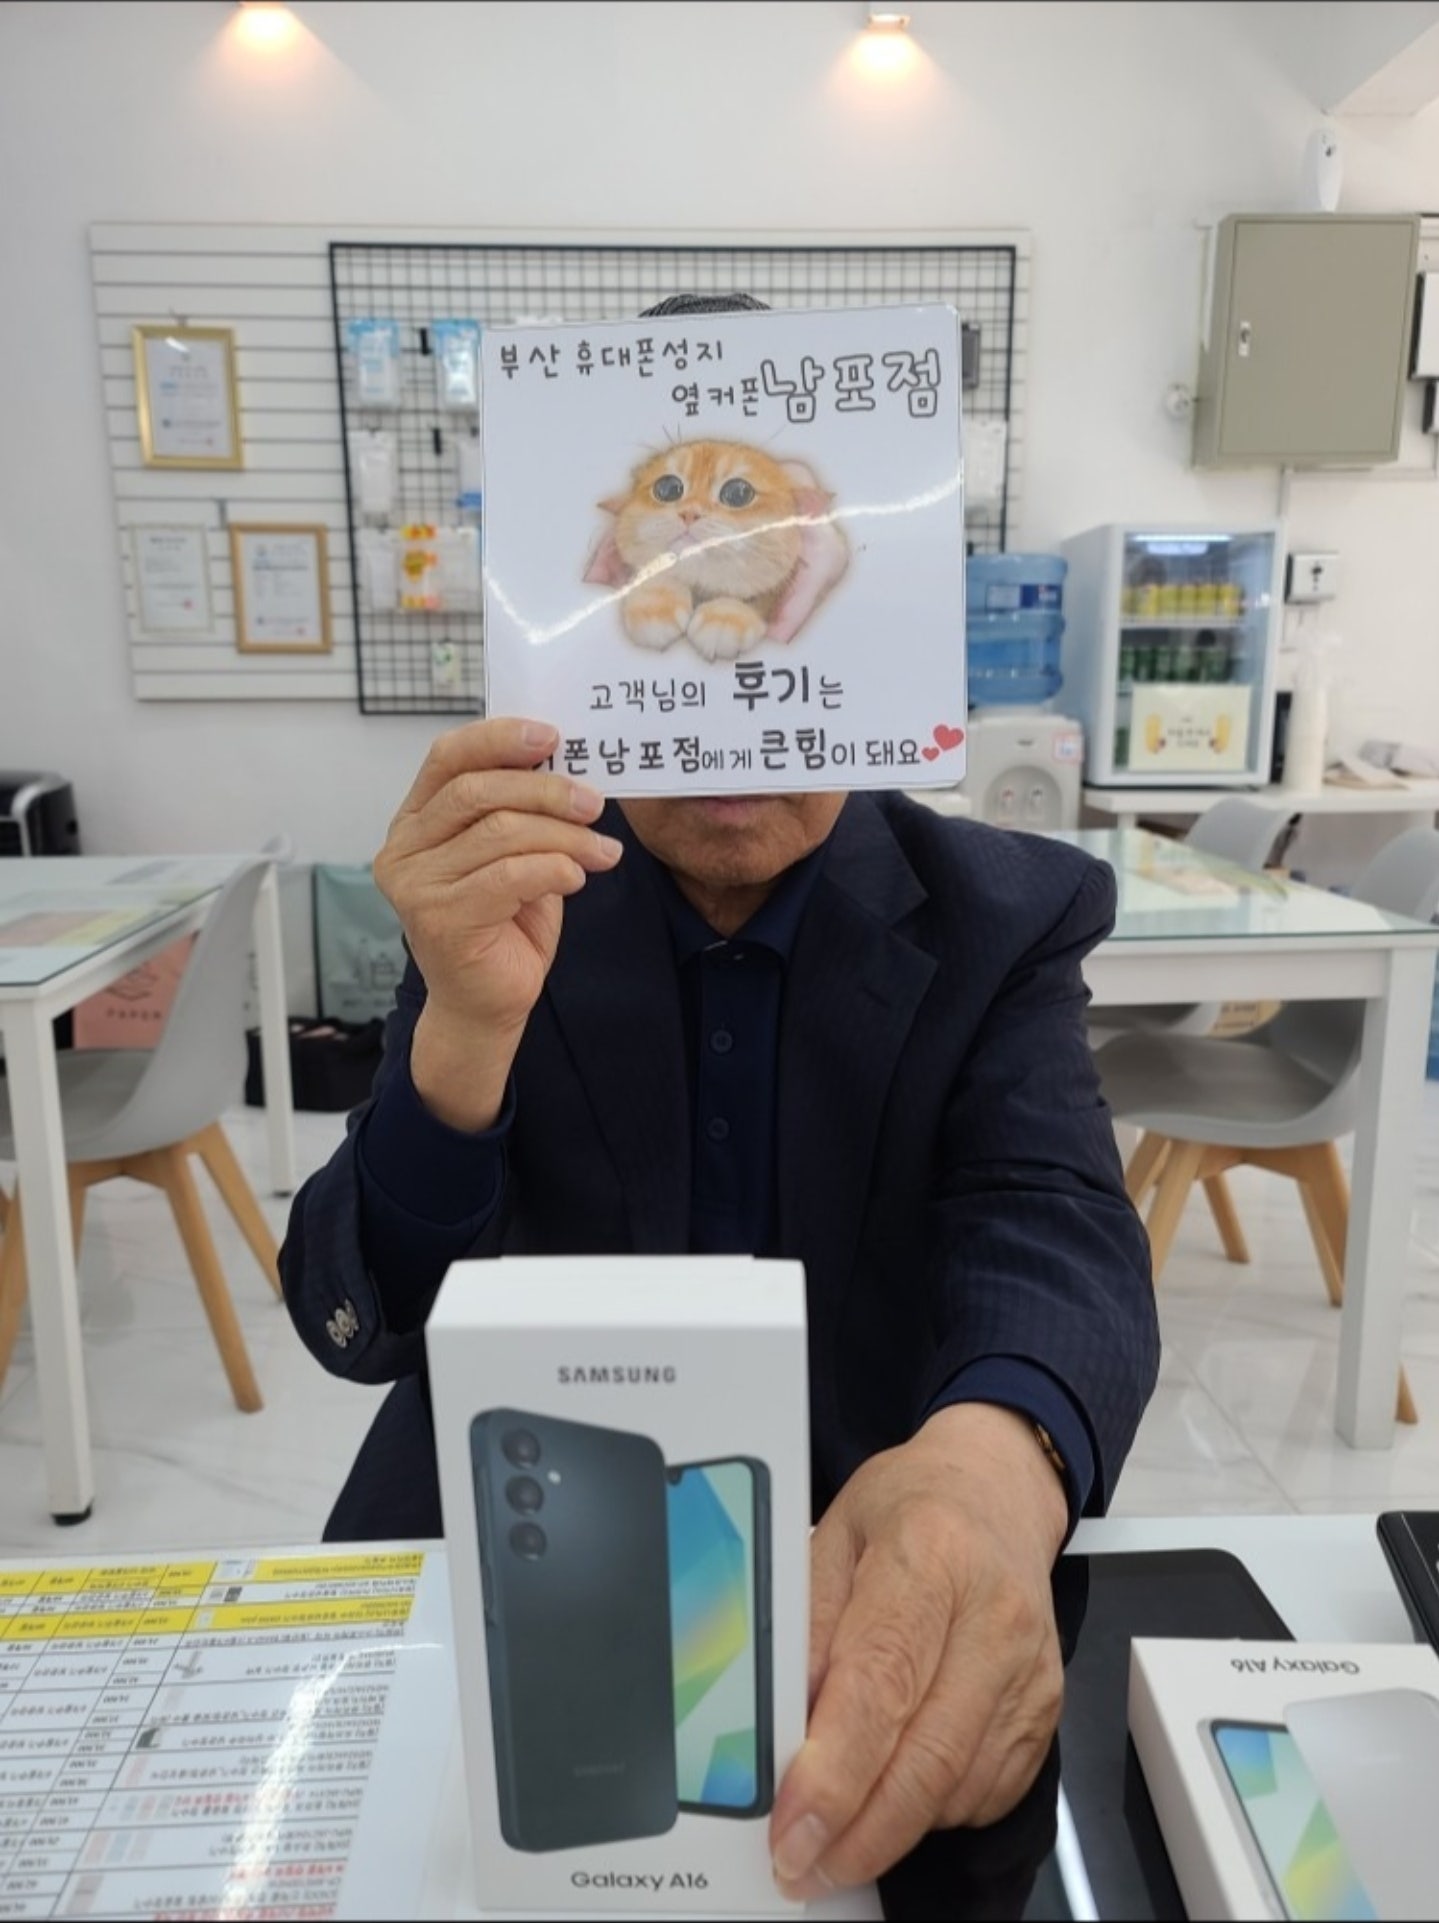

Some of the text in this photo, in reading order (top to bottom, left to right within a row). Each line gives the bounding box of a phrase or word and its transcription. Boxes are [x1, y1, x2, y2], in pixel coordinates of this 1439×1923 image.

[500, 343, 561, 380] 부산
[590, 678, 706, 713] 고객님의
[557, 1366, 677, 1384] SAMSUNG
[1230, 1655, 1360, 1675] Galaxy A16
[570, 1871, 709, 1892] Galaxy A16
